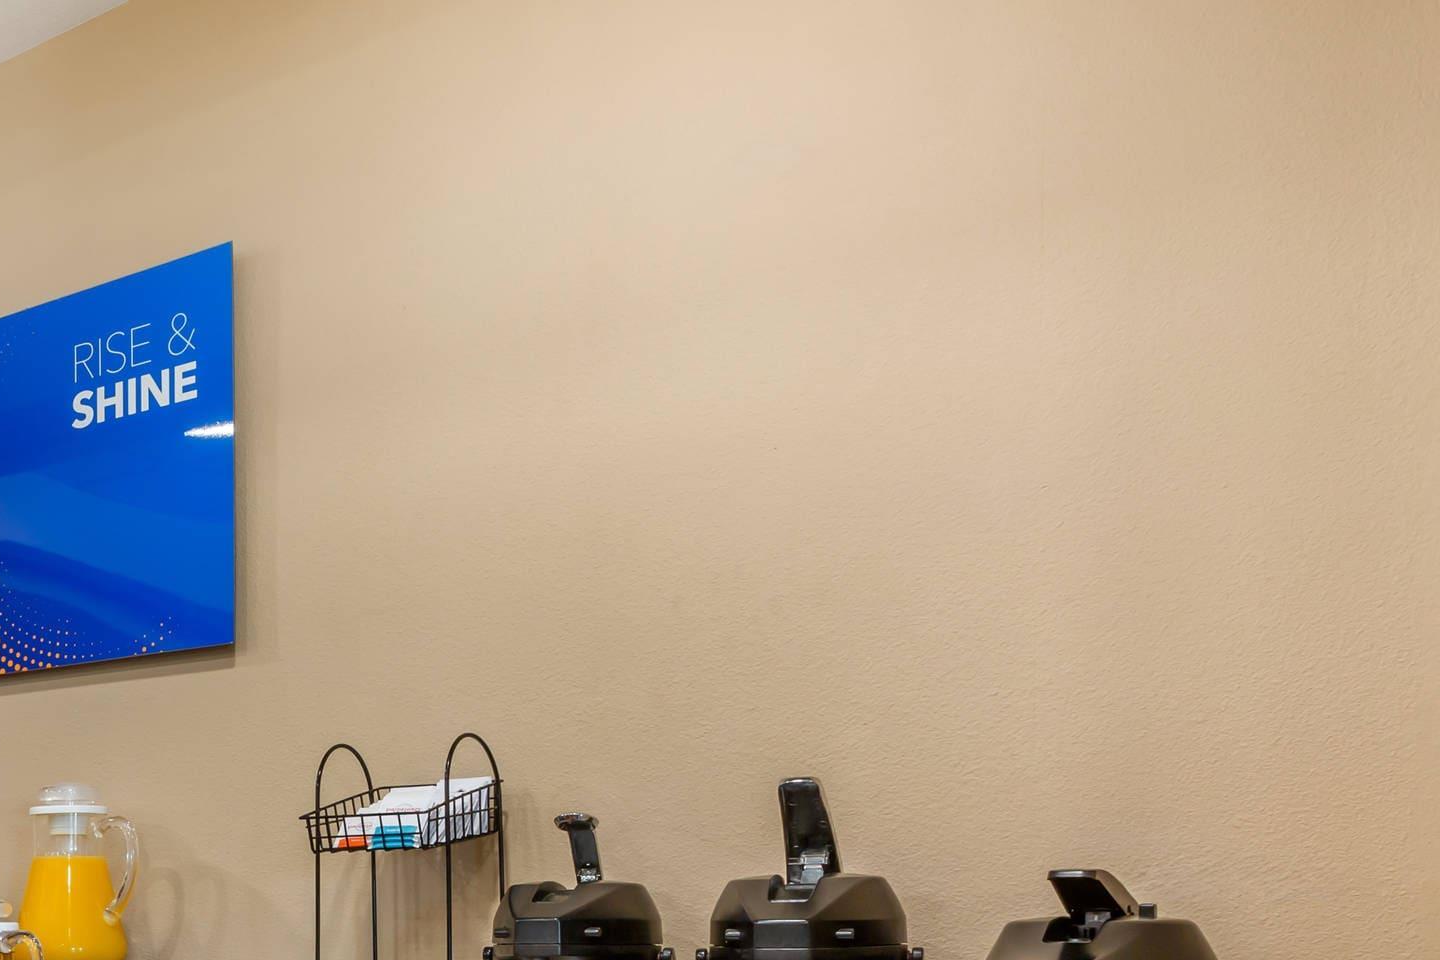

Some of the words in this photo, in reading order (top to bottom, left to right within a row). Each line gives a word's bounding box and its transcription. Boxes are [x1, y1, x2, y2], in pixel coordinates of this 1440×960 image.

[73, 322, 152, 385] RISE
[168, 312, 196, 356] &
[71, 360, 198, 430] SHINE
